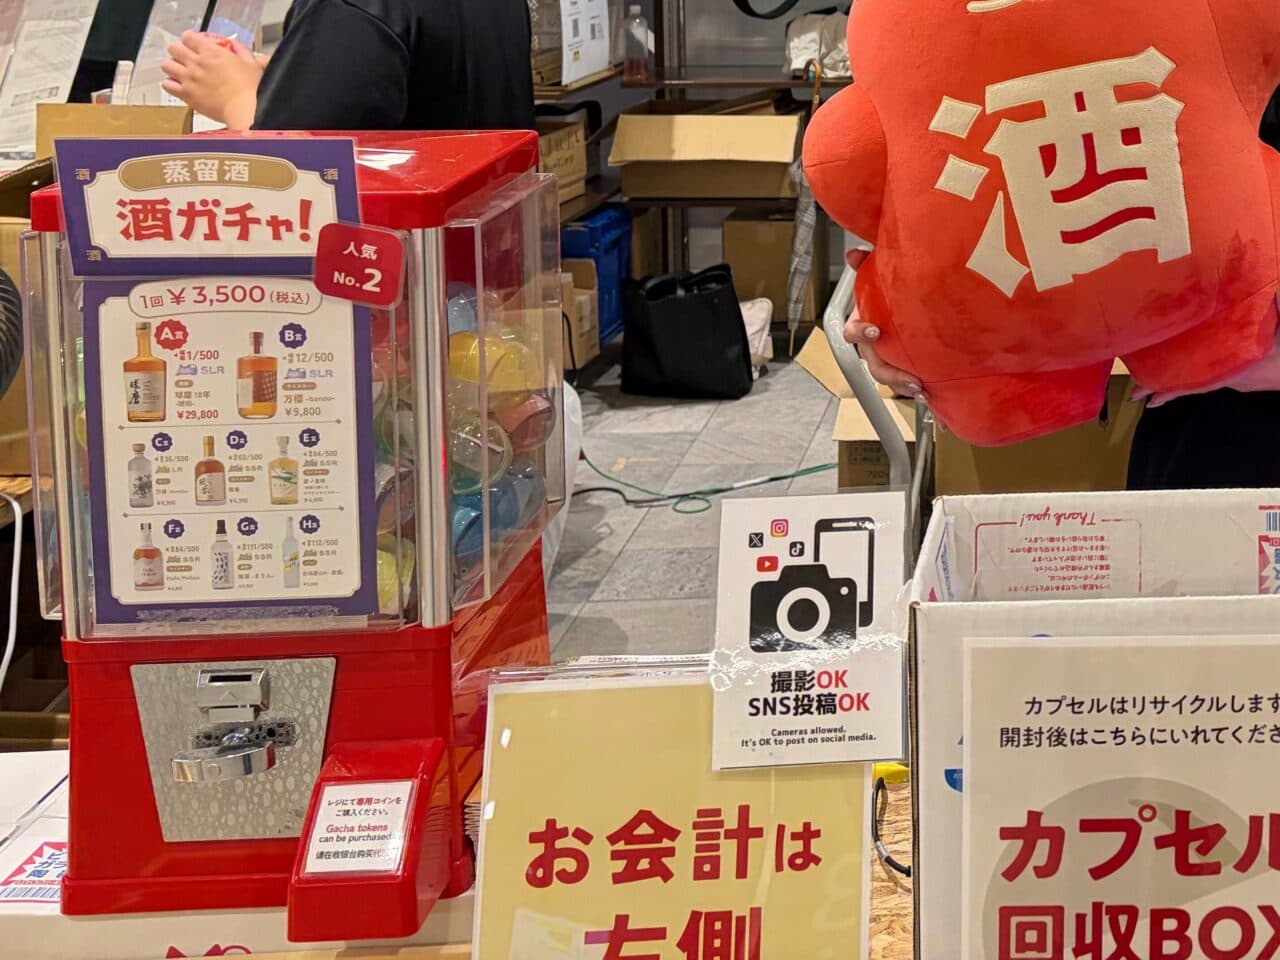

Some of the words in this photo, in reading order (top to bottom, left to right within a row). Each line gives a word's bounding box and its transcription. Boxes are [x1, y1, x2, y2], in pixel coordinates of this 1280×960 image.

[161, 159, 250, 183] 蒸留酒
[926, 43, 1193, 299] 酒
[115, 197, 313, 242] 酒ガチャ!
[342, 243, 378, 261] 人気
[332, 268, 383, 293] No.2
[139, 294, 164, 309] 1回
[200, 366, 225, 375] SLR
[310, 369, 334, 378] SLR
[177, 409, 219, 420] ¥29,800
[1020, 506, 1051, 528] you!
[1053, 511, 1096, 527] Thank
[770, 669, 849, 694] 撮影OK
[748, 692, 871, 717] SNS投稿OK
[771, 728, 808, 737] Cameras
[810, 725, 847, 735] allowed.
[759, 737, 772, 746] OK
[774, 737, 784, 746] to
[785, 736, 805, 747] post
[820, 734, 846, 743] social
[848, 732, 877, 742] media.
[327, 797, 402, 806] レジにて専用コインを
[336, 808, 389, 817] ご購入ください。
[326, 823, 355, 834] Gacha
[357, 822, 389, 833] tokens
[319, 835, 334, 843] can
[336, 834, 347, 843] be
[525, 804, 823, 889] お会計は
